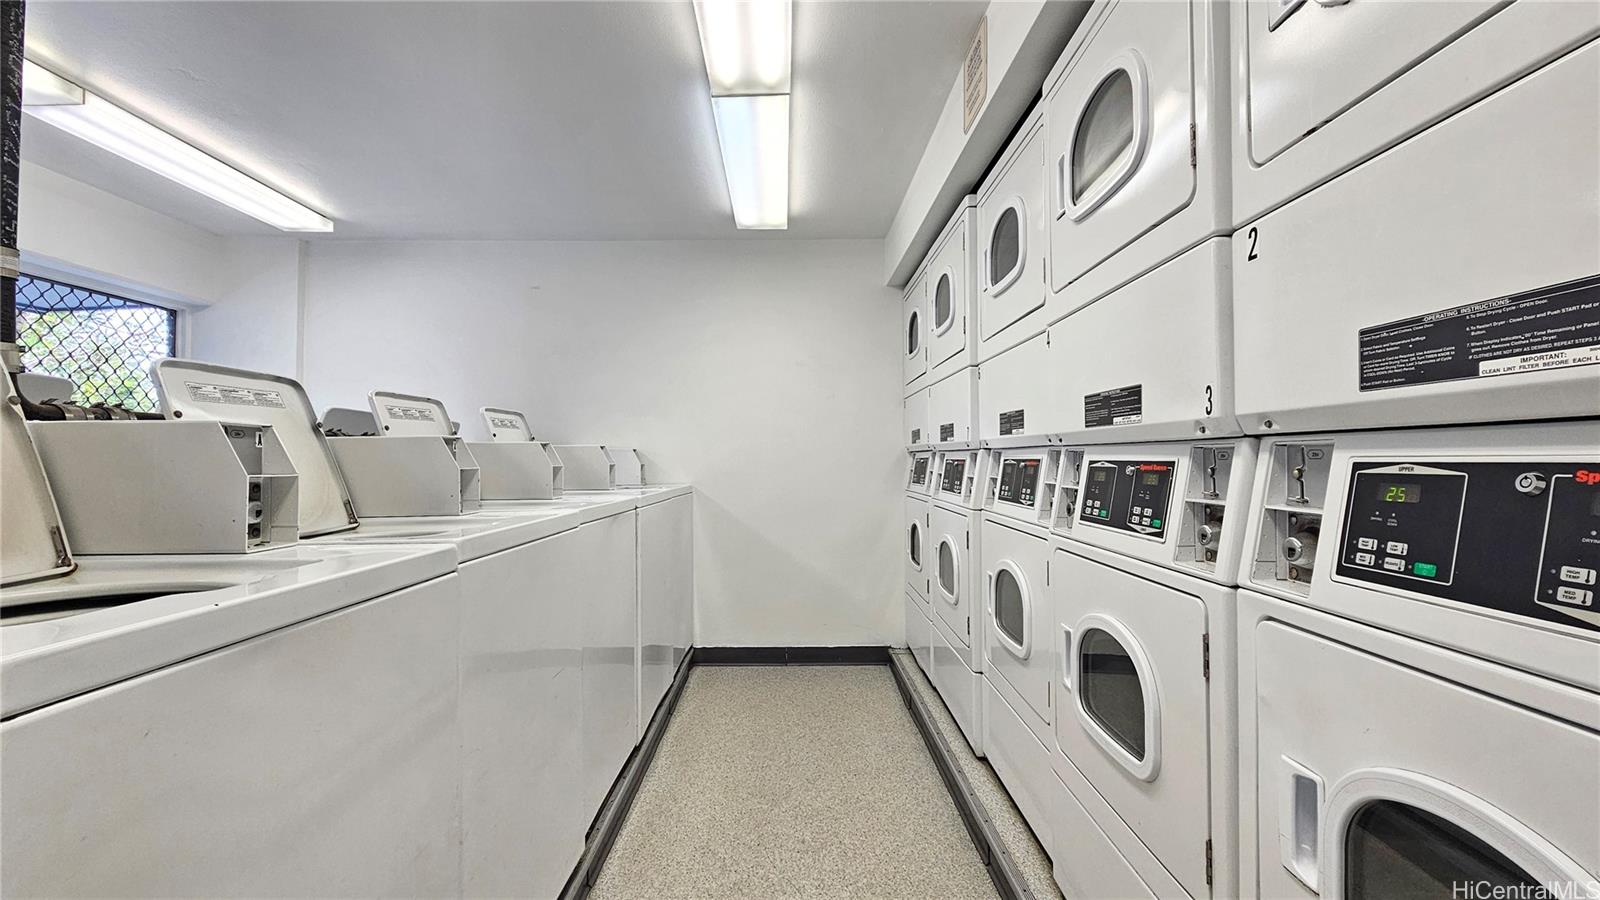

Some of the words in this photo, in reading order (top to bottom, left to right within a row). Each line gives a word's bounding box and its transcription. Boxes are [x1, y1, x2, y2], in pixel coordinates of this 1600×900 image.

[1248, 226, 1258, 262] 2
[1520, 352, 1567, 364] IMPORTANT:
[1206, 385, 1212, 416] 3
[1386, 488, 1406, 502] 25
